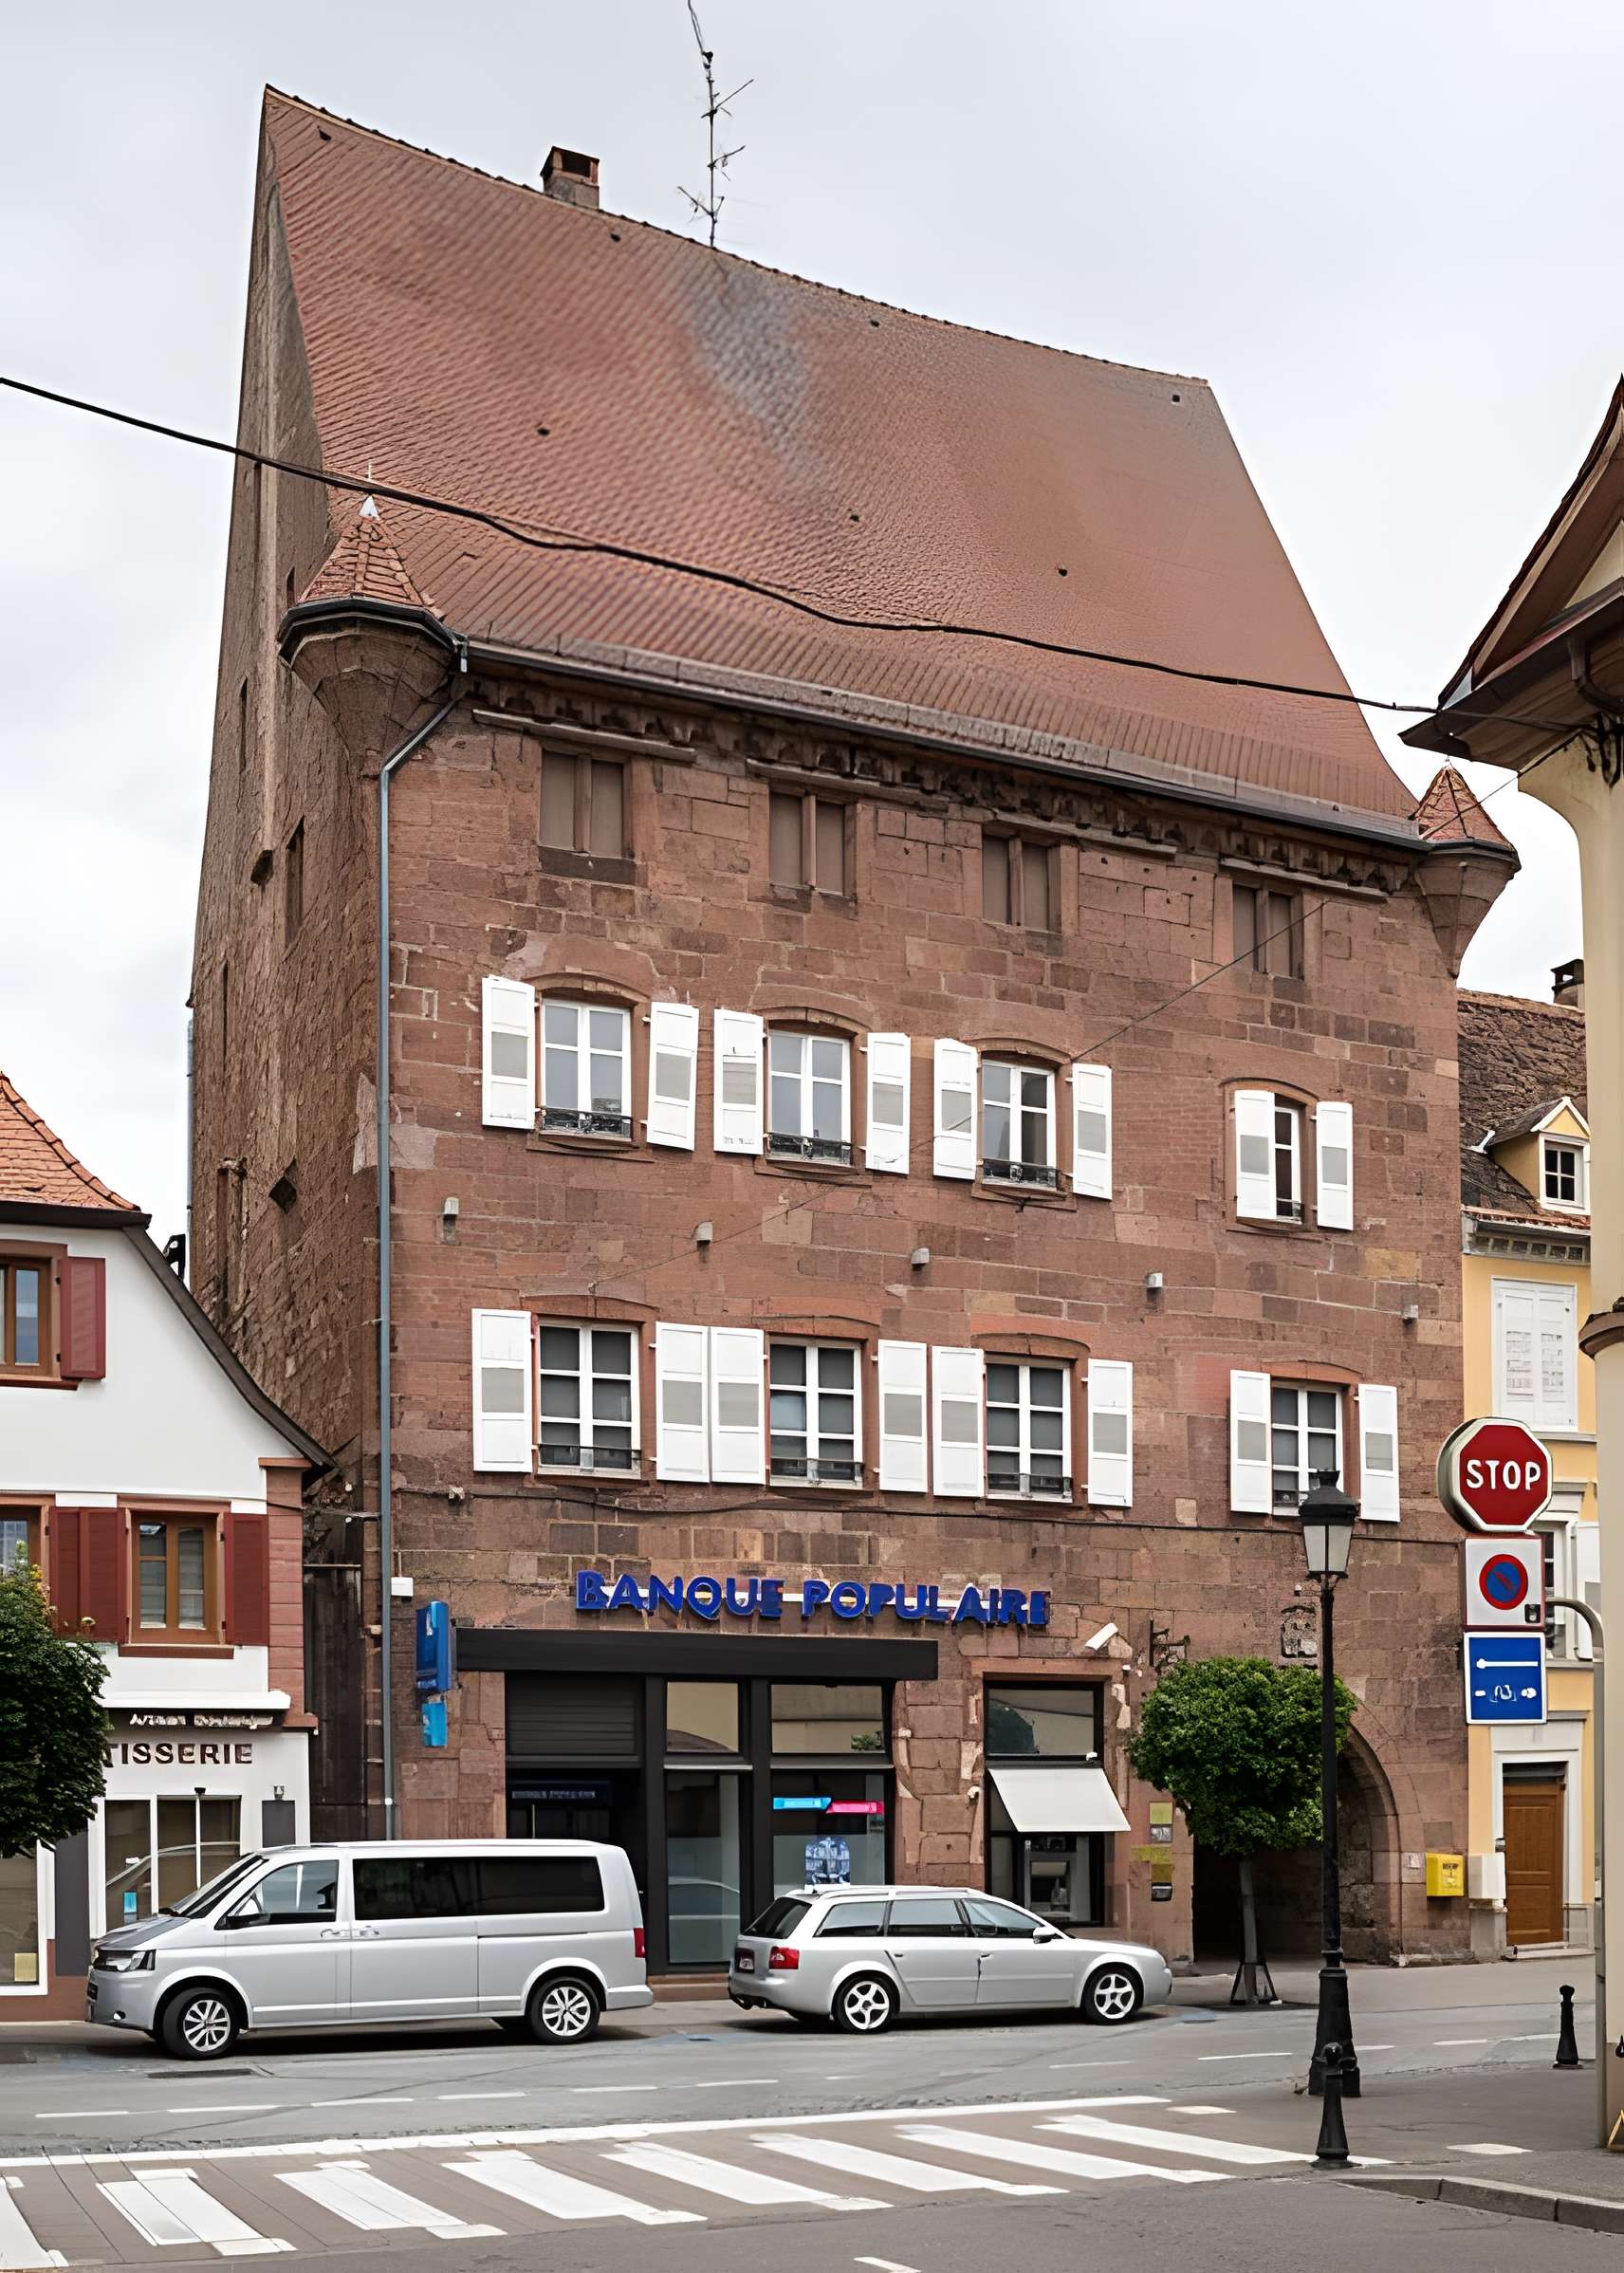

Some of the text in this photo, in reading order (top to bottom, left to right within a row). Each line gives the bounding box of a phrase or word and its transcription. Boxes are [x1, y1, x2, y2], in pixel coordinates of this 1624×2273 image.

[1466, 1459, 1541, 1490] STOP
[576, 1570, 1051, 1624] BANQUE POPULAIRE
